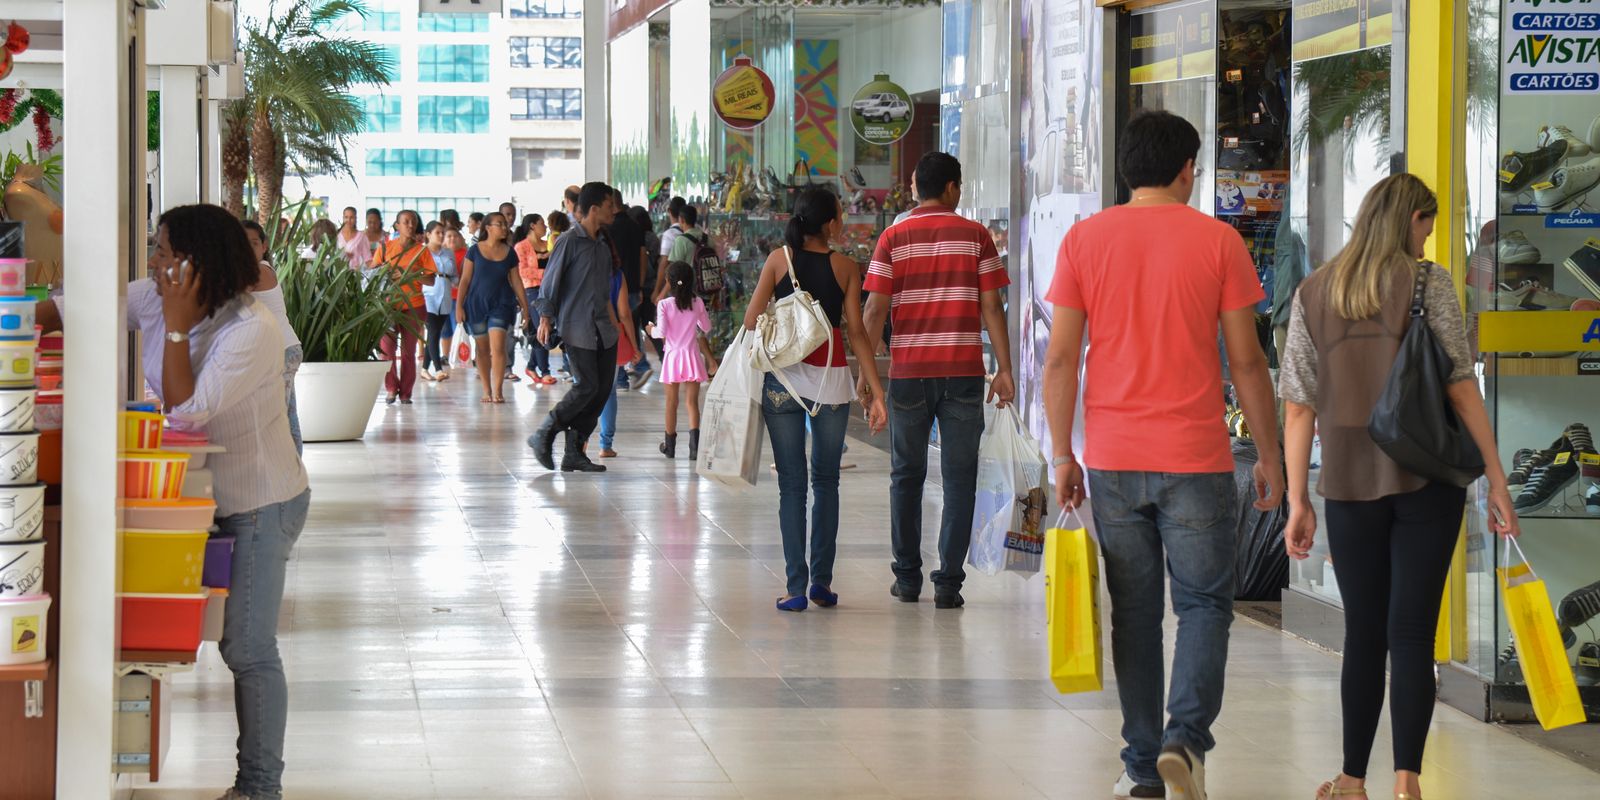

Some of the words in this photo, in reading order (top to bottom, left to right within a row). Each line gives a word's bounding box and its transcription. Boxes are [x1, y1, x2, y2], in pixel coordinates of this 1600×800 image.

[1519, 13, 1597, 28] CARTÕES
[1507, 34, 1600, 67] AVISTA
[1516, 73, 1594, 88] CARTÕES
